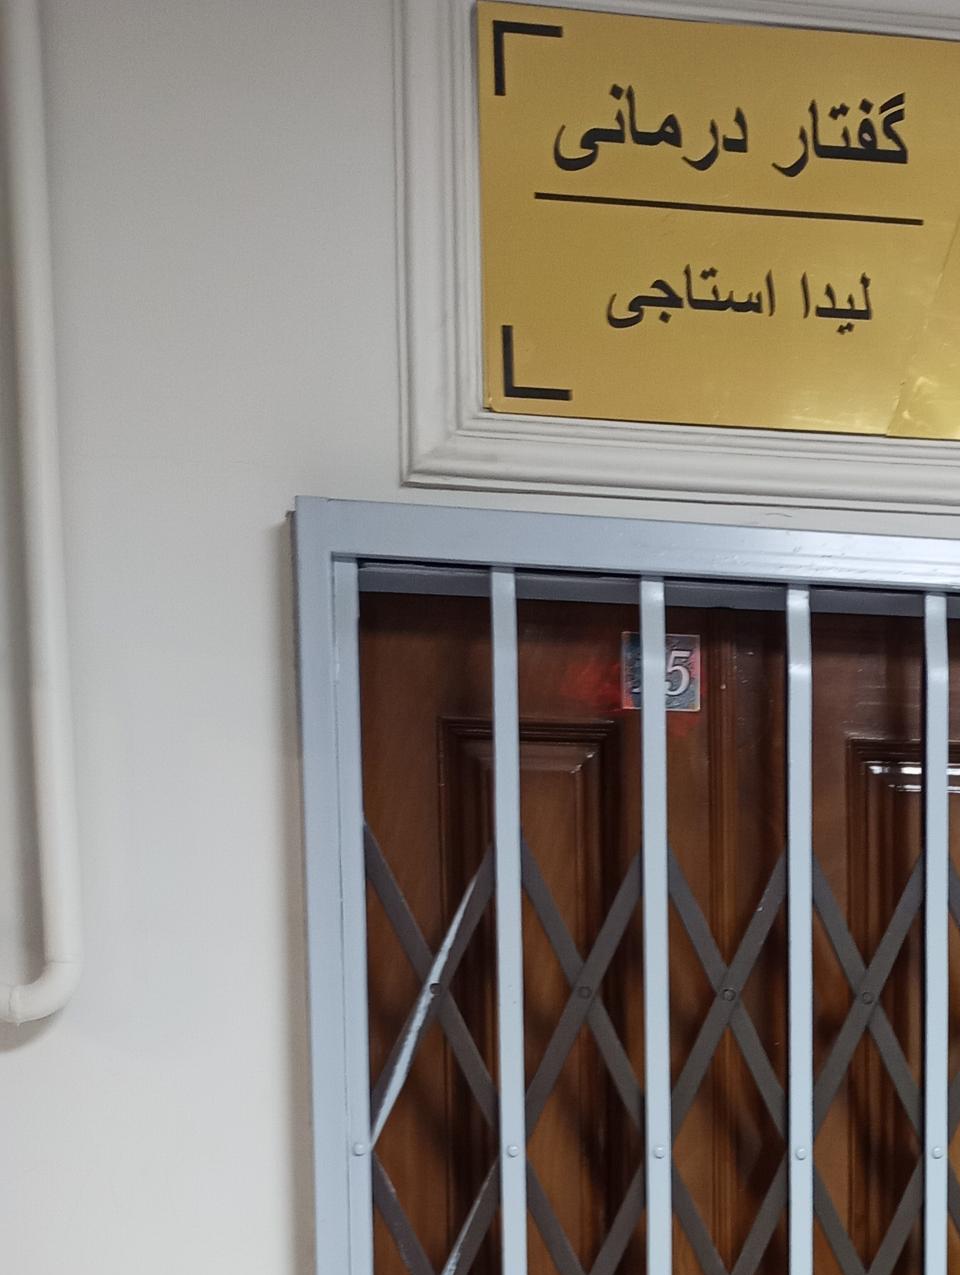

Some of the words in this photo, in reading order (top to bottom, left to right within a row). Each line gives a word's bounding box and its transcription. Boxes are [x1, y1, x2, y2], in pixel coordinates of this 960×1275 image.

[553, 83, 748, 172] درمانی
[771, 92, 909, 178] گفتار
[606, 264, 775, 329] استاجی
[801, 272, 872, 334] لیدا
[631, 650, 691, 696] 5
